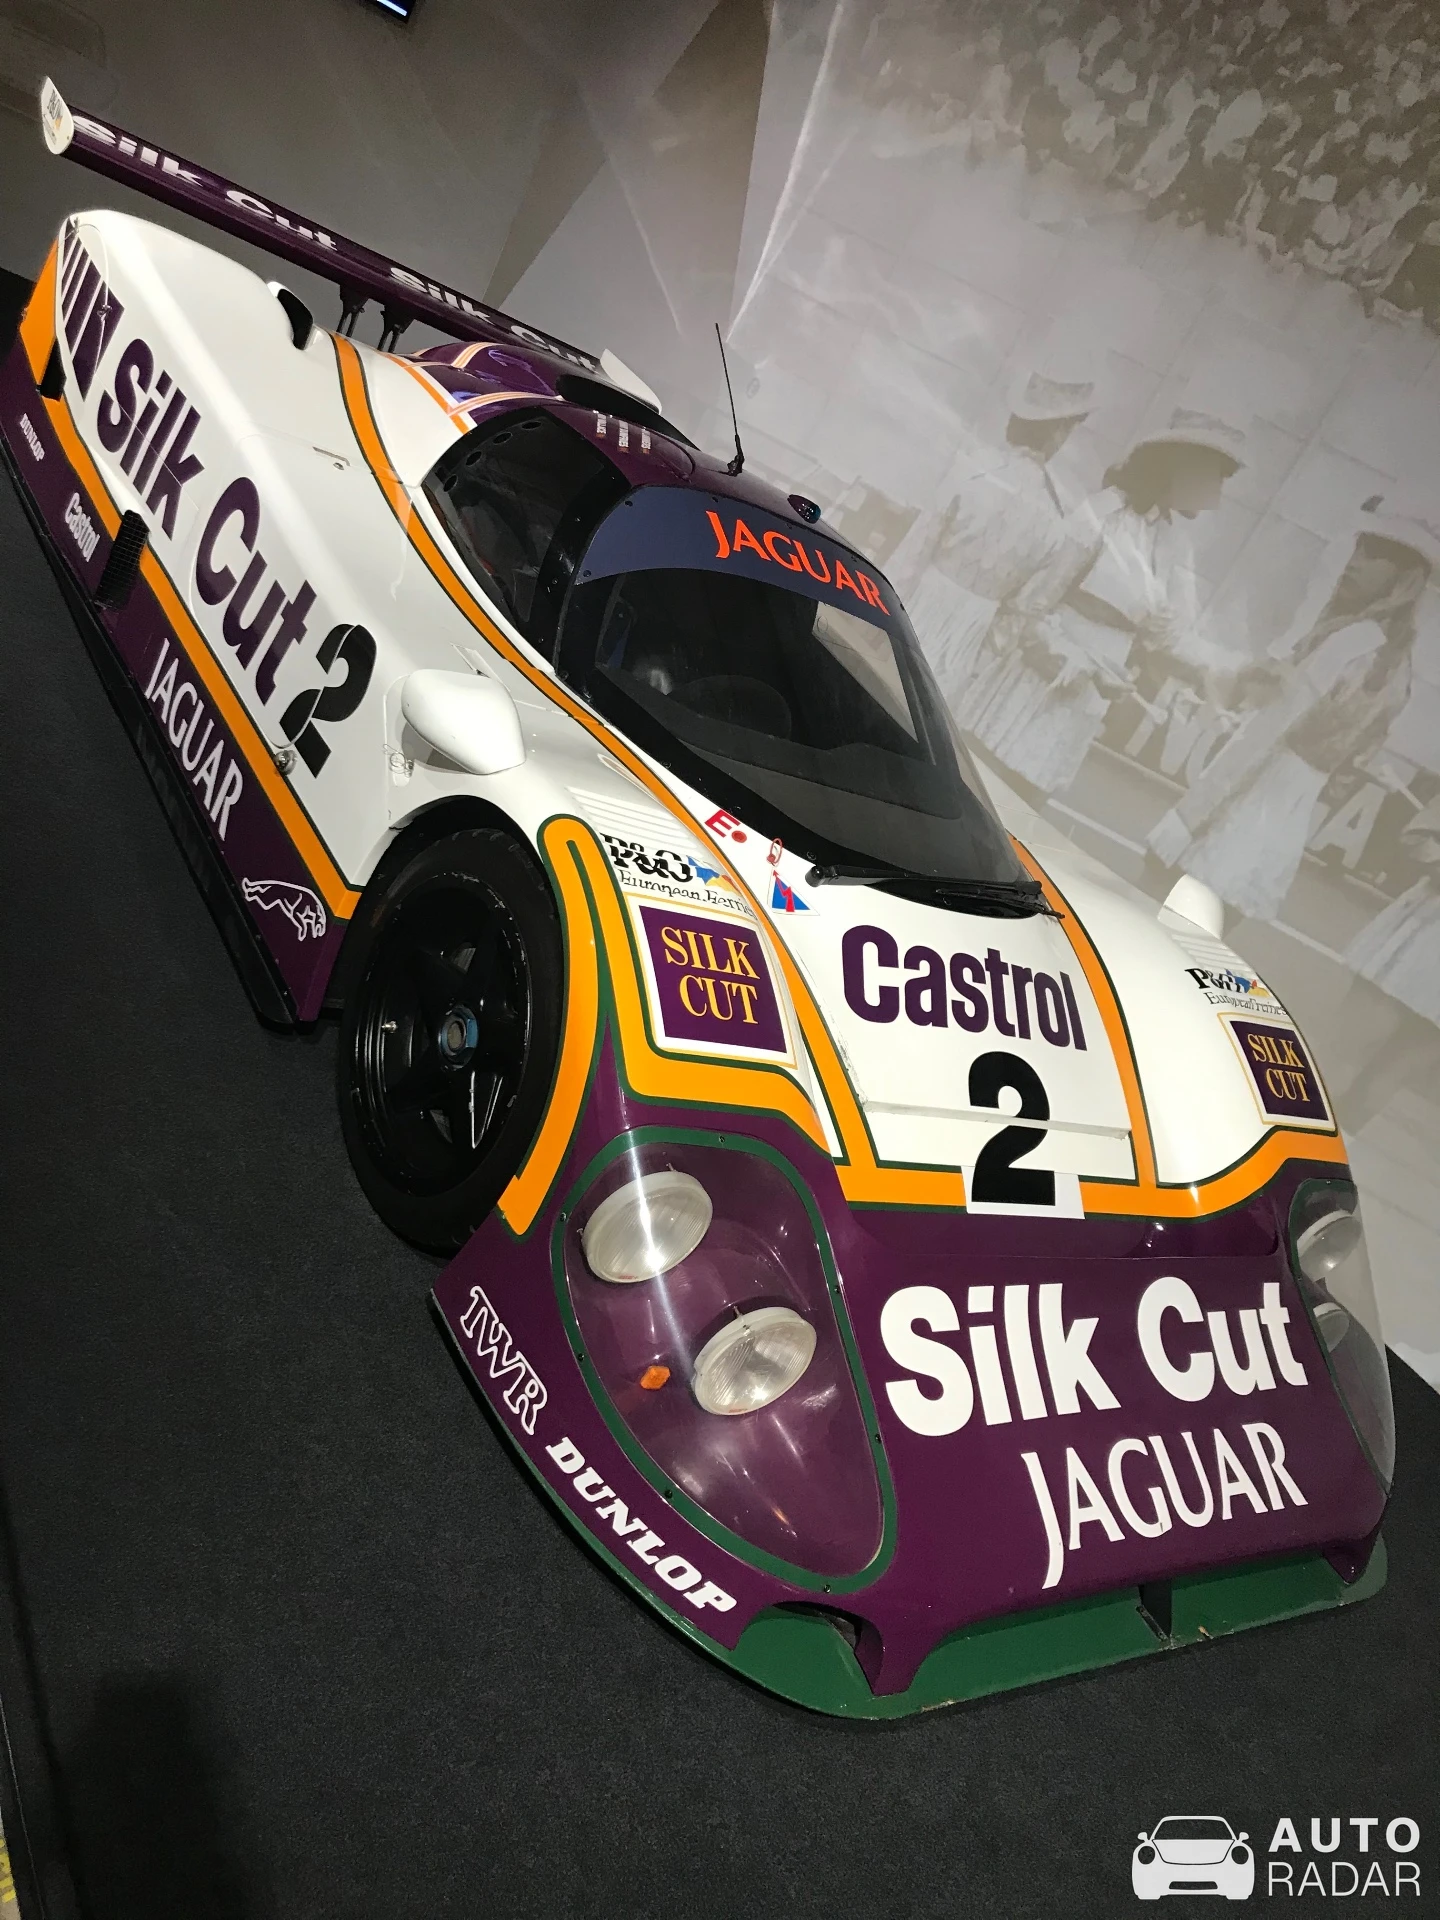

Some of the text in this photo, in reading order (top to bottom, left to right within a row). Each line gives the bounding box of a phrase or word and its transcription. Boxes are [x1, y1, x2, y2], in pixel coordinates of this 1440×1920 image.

[72, 115, 204, 187] Silk
[224, 189, 339, 251] Cut
[390, 267, 600, 375] Silk Cut
[19, 413, 46, 462] DUNLOP
[64, 492, 101, 563] Castrol
[97, 338, 317, 706] Silk Cut
[705, 509, 891, 616] JAGUAR
[145, 638, 244, 841] JAGUAR
[279, 623, 377, 778] 2
[599, 832, 694, 883] P&O
[618, 869, 701, 901] European
[661, 926, 760, 979] SILK
[679, 975, 759, 1024] CUT
[841, 924, 1087, 1051] Castrol
[1247, 1033, 1305, 1069] SILK
[1265, 1067, 1311, 1102] CUT
[968, 1050, 1056, 1206] 2
[460, 1285, 548, 1435] TWR
[880, 1276, 1308, 1437] Silk Cut
[545, 1436, 737, 1612] DUNLOP
[1021, 1422, 1308, 1590] JAGUAR
